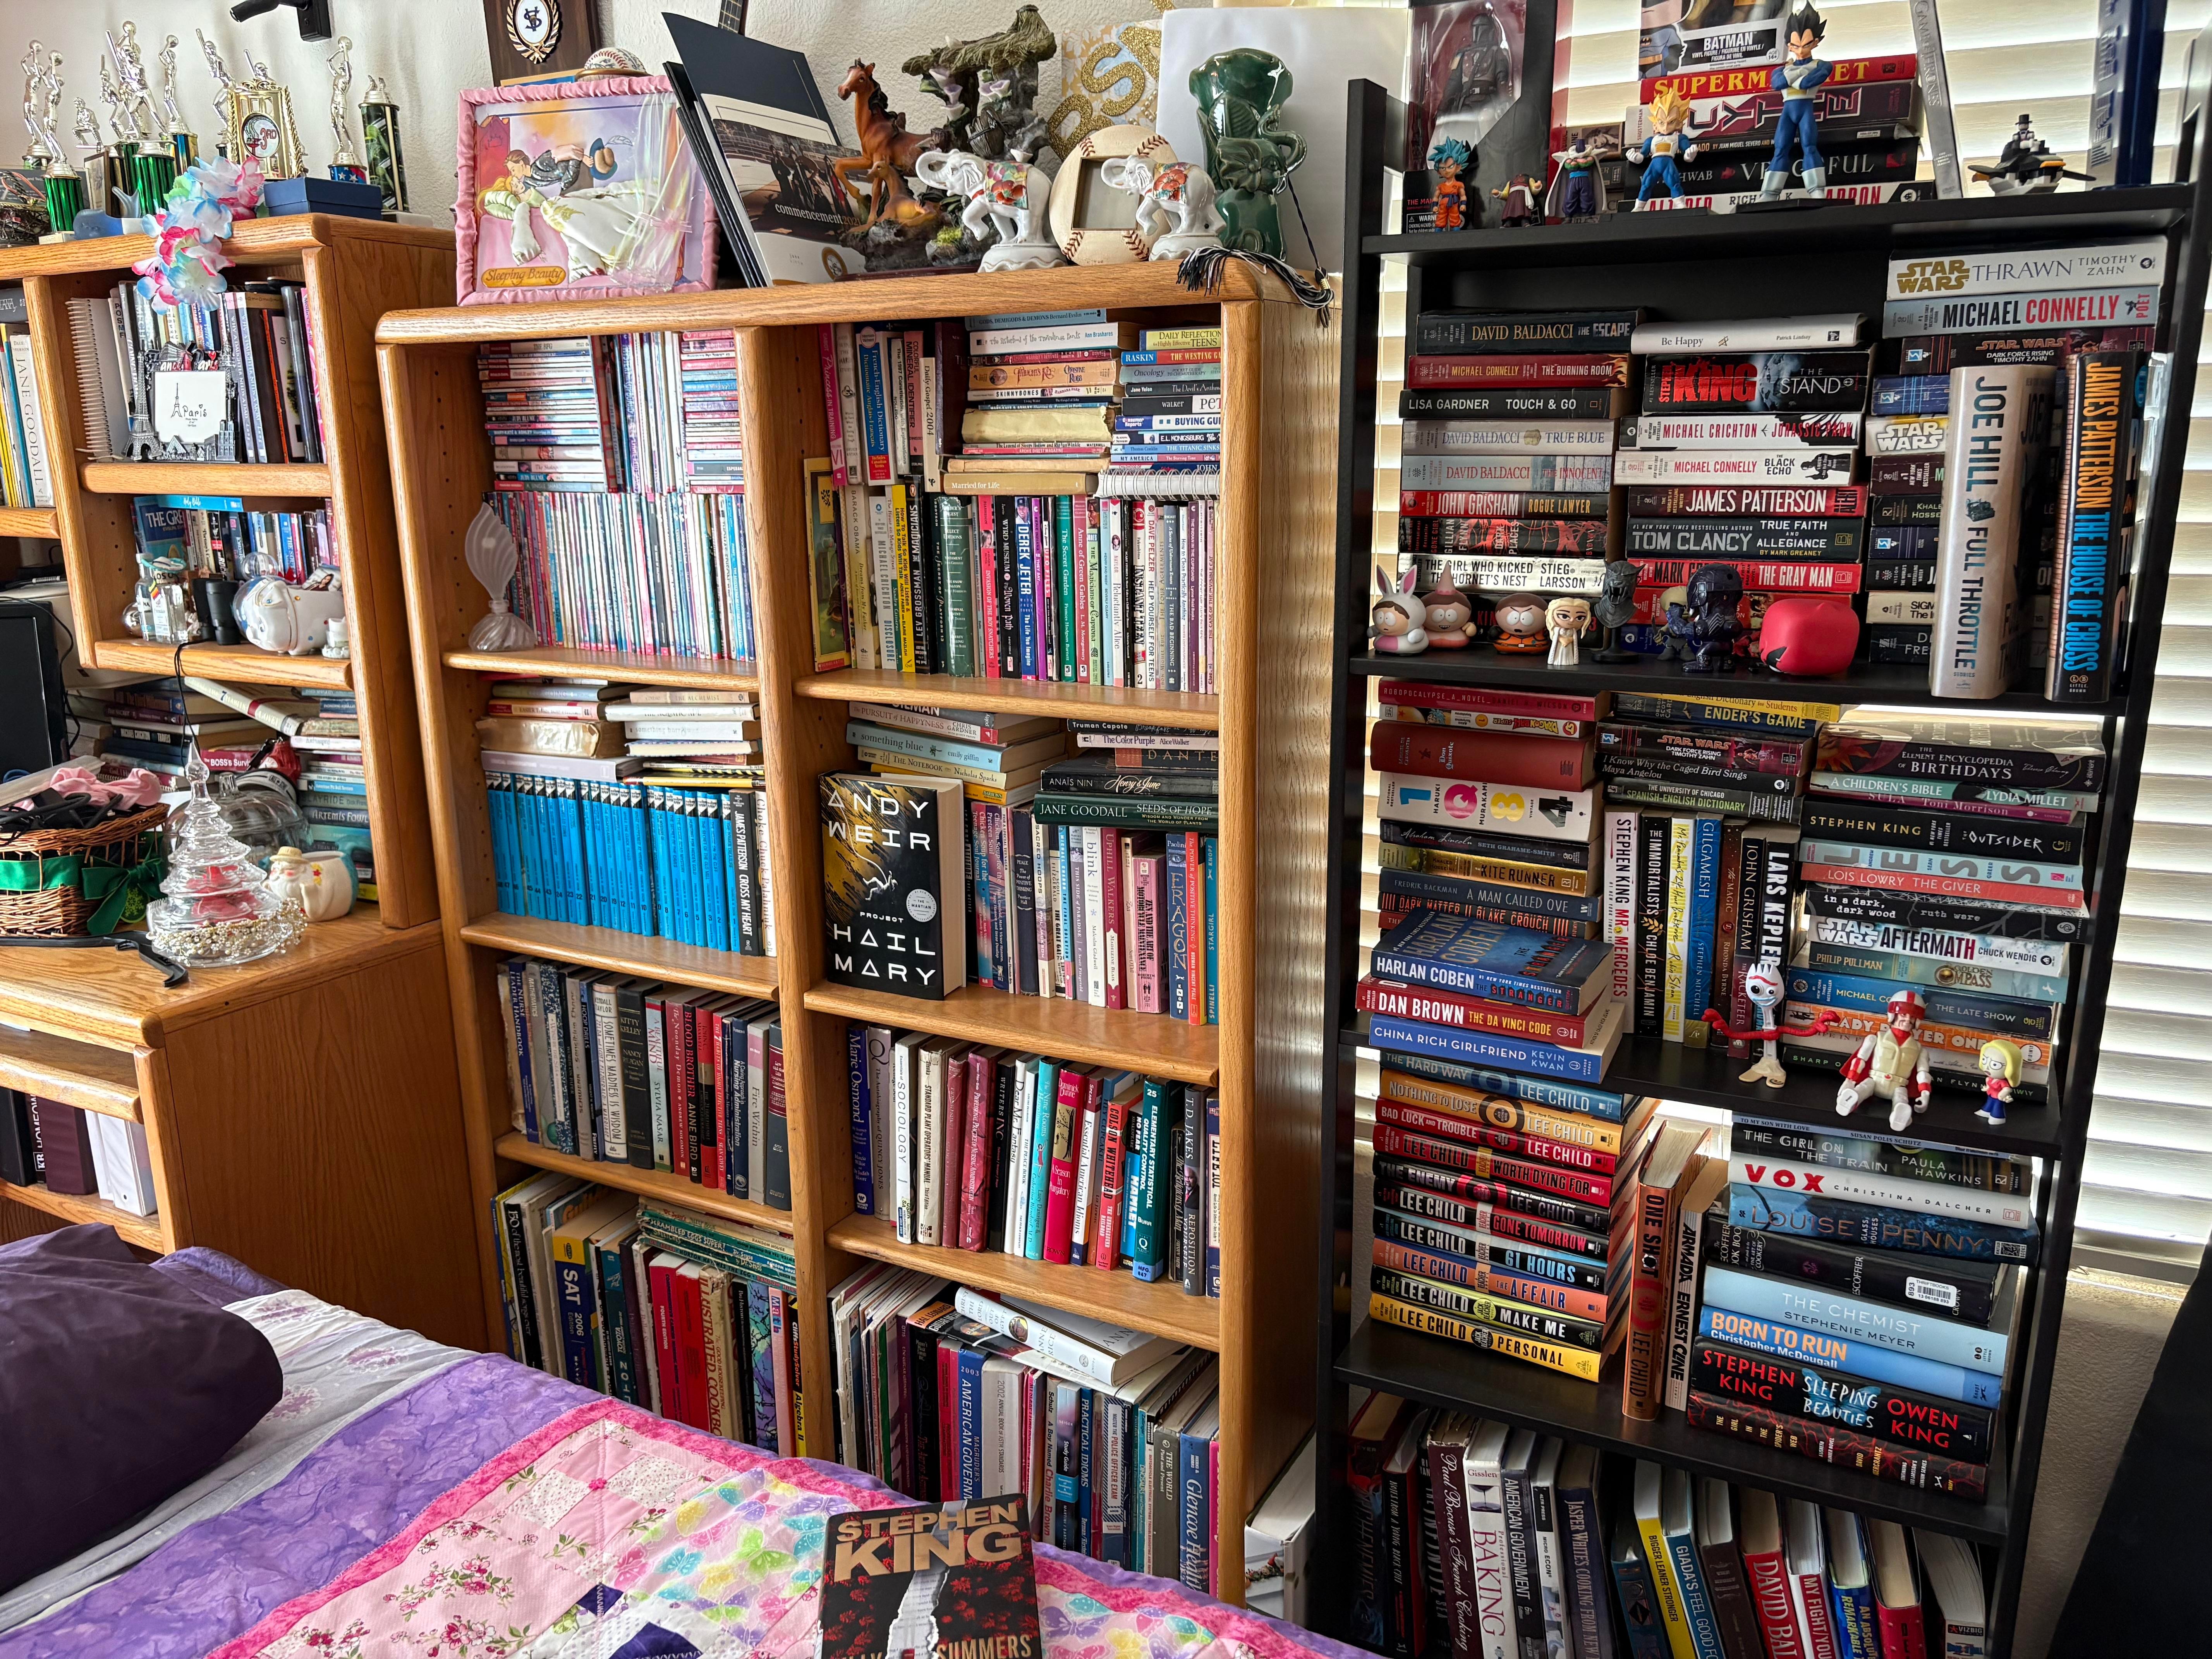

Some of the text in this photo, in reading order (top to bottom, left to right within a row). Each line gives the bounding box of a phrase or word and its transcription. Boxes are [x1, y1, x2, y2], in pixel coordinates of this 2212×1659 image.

[1704, 32, 1753, 50] BATMAN
[775, 201, 843, 225] commencement
[1972, 259, 2072, 282] THRAWN
[2078, 255, 2136, 266] TIMOTHY
[2087, 266, 2125, 276] ZAHN
[486, 268, 564, 285] Sleeping Beauty
[1472, 322, 1630, 341] DAVID BALDACCI THE ESCAPE
[1662, 337, 1703, 347] Be Happy
[1125, 354, 1154, 362] RASKIN
[1780, 378, 1841, 393] STAND
[183, 404, 207, 417] Paris
[1409, 399, 1576, 410] LISA GARDNER TOUCH & GO
[15, 359, 44, 486] JANE GOODALL
[1966, 376, 2007, 492] JOE HILL
[1765, 459, 1795, 467] BLACK
[1767, 466, 1791, 475] ECHO
[1528, 499, 1591, 513] ROGUE LAWYER
[1686, 489, 1827, 512] JAMES PATTERSON
[1633, 532, 1752, 551] TOM CLANCY
[1018, 526, 1032, 595] DEREK JETER
[1759, 565, 1832, 587] THE GRAY MAN
[1954, 527, 1988, 670] FULL THROTTLE
[2063, 511, 2110, 672] THE HOUSE OF CROSS
[1704, 706, 1805, 728] ENDER'S GAME
[861, 733, 923, 752] something blue
[1049, 776, 1092, 787] ANAÏS NIN
[1911, 761, 2012, 779] BIRTHDAYS
[1040, 804, 1127, 818] JANE GOODALL
[1479, 782, 1487, 825] MURAKAMI
[829, 820, 930, 851] WEIR
[1810, 815, 1921, 836] STEPHEN KING
[1087, 842, 1097, 878] blink
[1106, 833, 1115, 871] UPHILL
[1481, 864, 1555, 887] KITE RUNNER
[1828, 870, 1903, 886] LOIS LOWRY
[1913, 877, 1981, 894] THE GIVER
[860, 912, 904, 923] PROJECT
[1170, 872, 1187, 970] ERAGON
[834, 924, 936, 956] HAIL
[1880, 926, 1975, 960] AFTERMATH
[835, 953, 936, 986] MARY
[1377, 957, 1474, 989] HARLAN COBEN
[1644, 934, 1657, 1017] CHLOE BENJAMIN
[1379, 993, 1464, 1024] DAN BROWN
[1936, 1004, 2015, 1022] THE LATE SHOW
[1468, 1012, 1551, 1036] THE DA VINCI CODE
[685, 1011, 696, 1097] BLOOD BROTHER
[654, 1081, 662, 1111] SYLVIA
[1147, 1089, 1157, 1097] 25
[752, 1112, 760, 1147] Within
[1185, 1123, 1194, 1160] JAKES
[1146, 1159, 1154, 1209] STATISTICAL
[1744, 1164, 1826, 1193] VOX
[1129, 1175, 1140, 1228] HAMLET
[1835, 1185, 1991, 1214] CHRISTINA DALCHER
[1401, 1223, 1466, 1254] LEE CHILD
[1505, 1250, 1575, 1283] 61 HOURS
[563, 1268, 581, 1305] SAT
[574, 1312, 584, 1336] 2006
[1782, 1293, 1920, 1335] THE CHEMIST
[1711, 1311, 1847, 1360] BORN TO RUN
[1498, 1336, 1564, 1367] PERSONAL
[961, 1366, 979, 1376] 2003
[1802, 1376, 1878, 1409] SLEEPING
[1803, 1397, 1874, 1428] BEAUTIES
[1887, 1398, 1958, 1430] OWEN
[1891, 1419, 1949, 1448] KING
[1468, 1469, 1497, 1478] Gisslen
[837, 1503, 1018, 1542] STEPHEN
[834, 1523, 1022, 1583] KING
[1473, 1529, 1505, 1636] BAKING
[1649, 1535, 1678, 1622] BIGGER LEANER STRONGER
[938, 1635, 1032, 1659] SUMMERS
